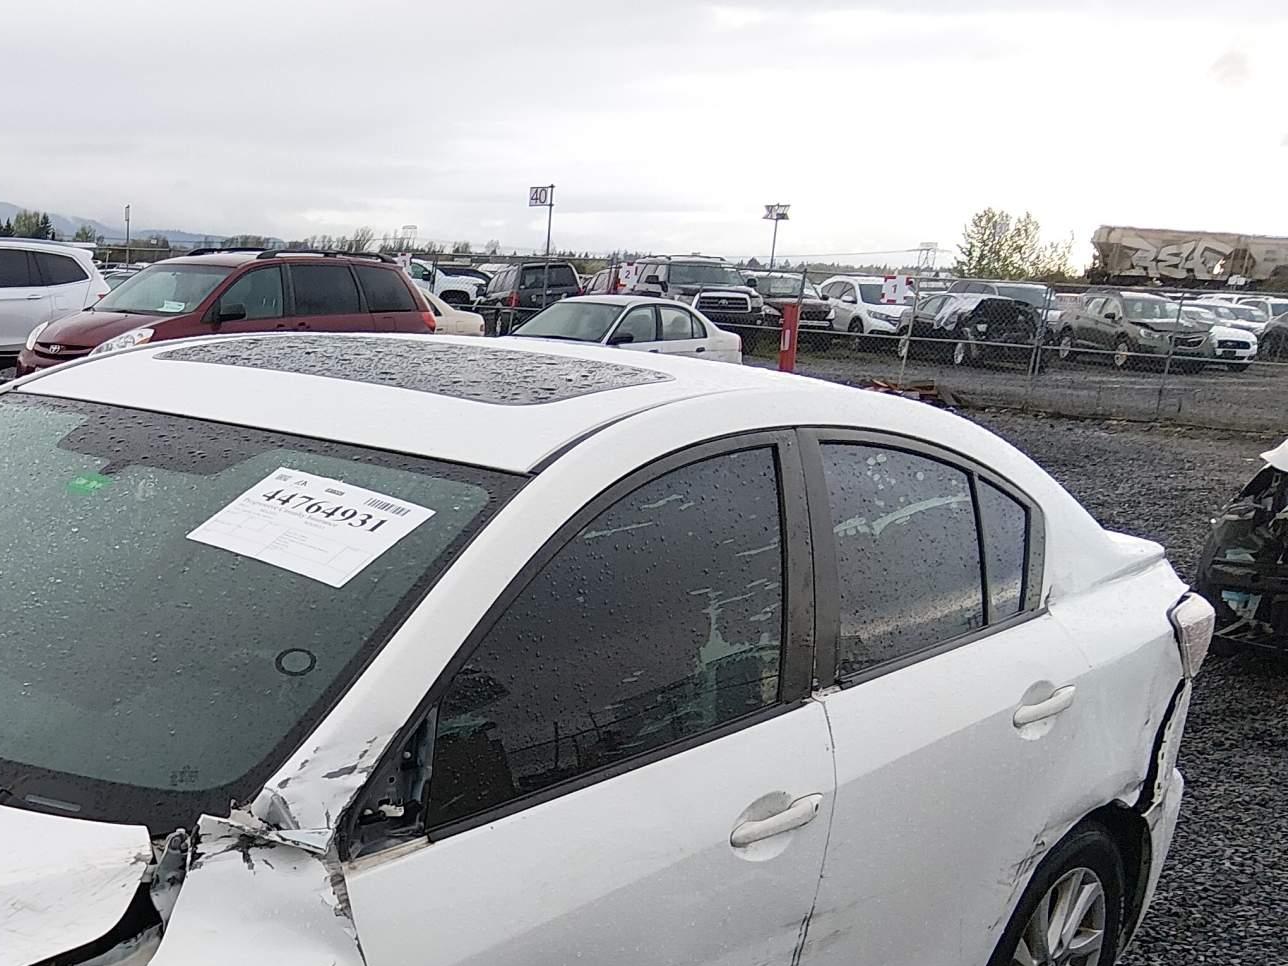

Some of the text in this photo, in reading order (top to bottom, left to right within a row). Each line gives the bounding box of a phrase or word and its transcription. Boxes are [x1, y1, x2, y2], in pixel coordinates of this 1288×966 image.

[530, 188, 547, 204] 40
[624, 270, 631, 279] 2
[890, 284, 897, 294] 1
[262, 488, 388, 532] 44764931
